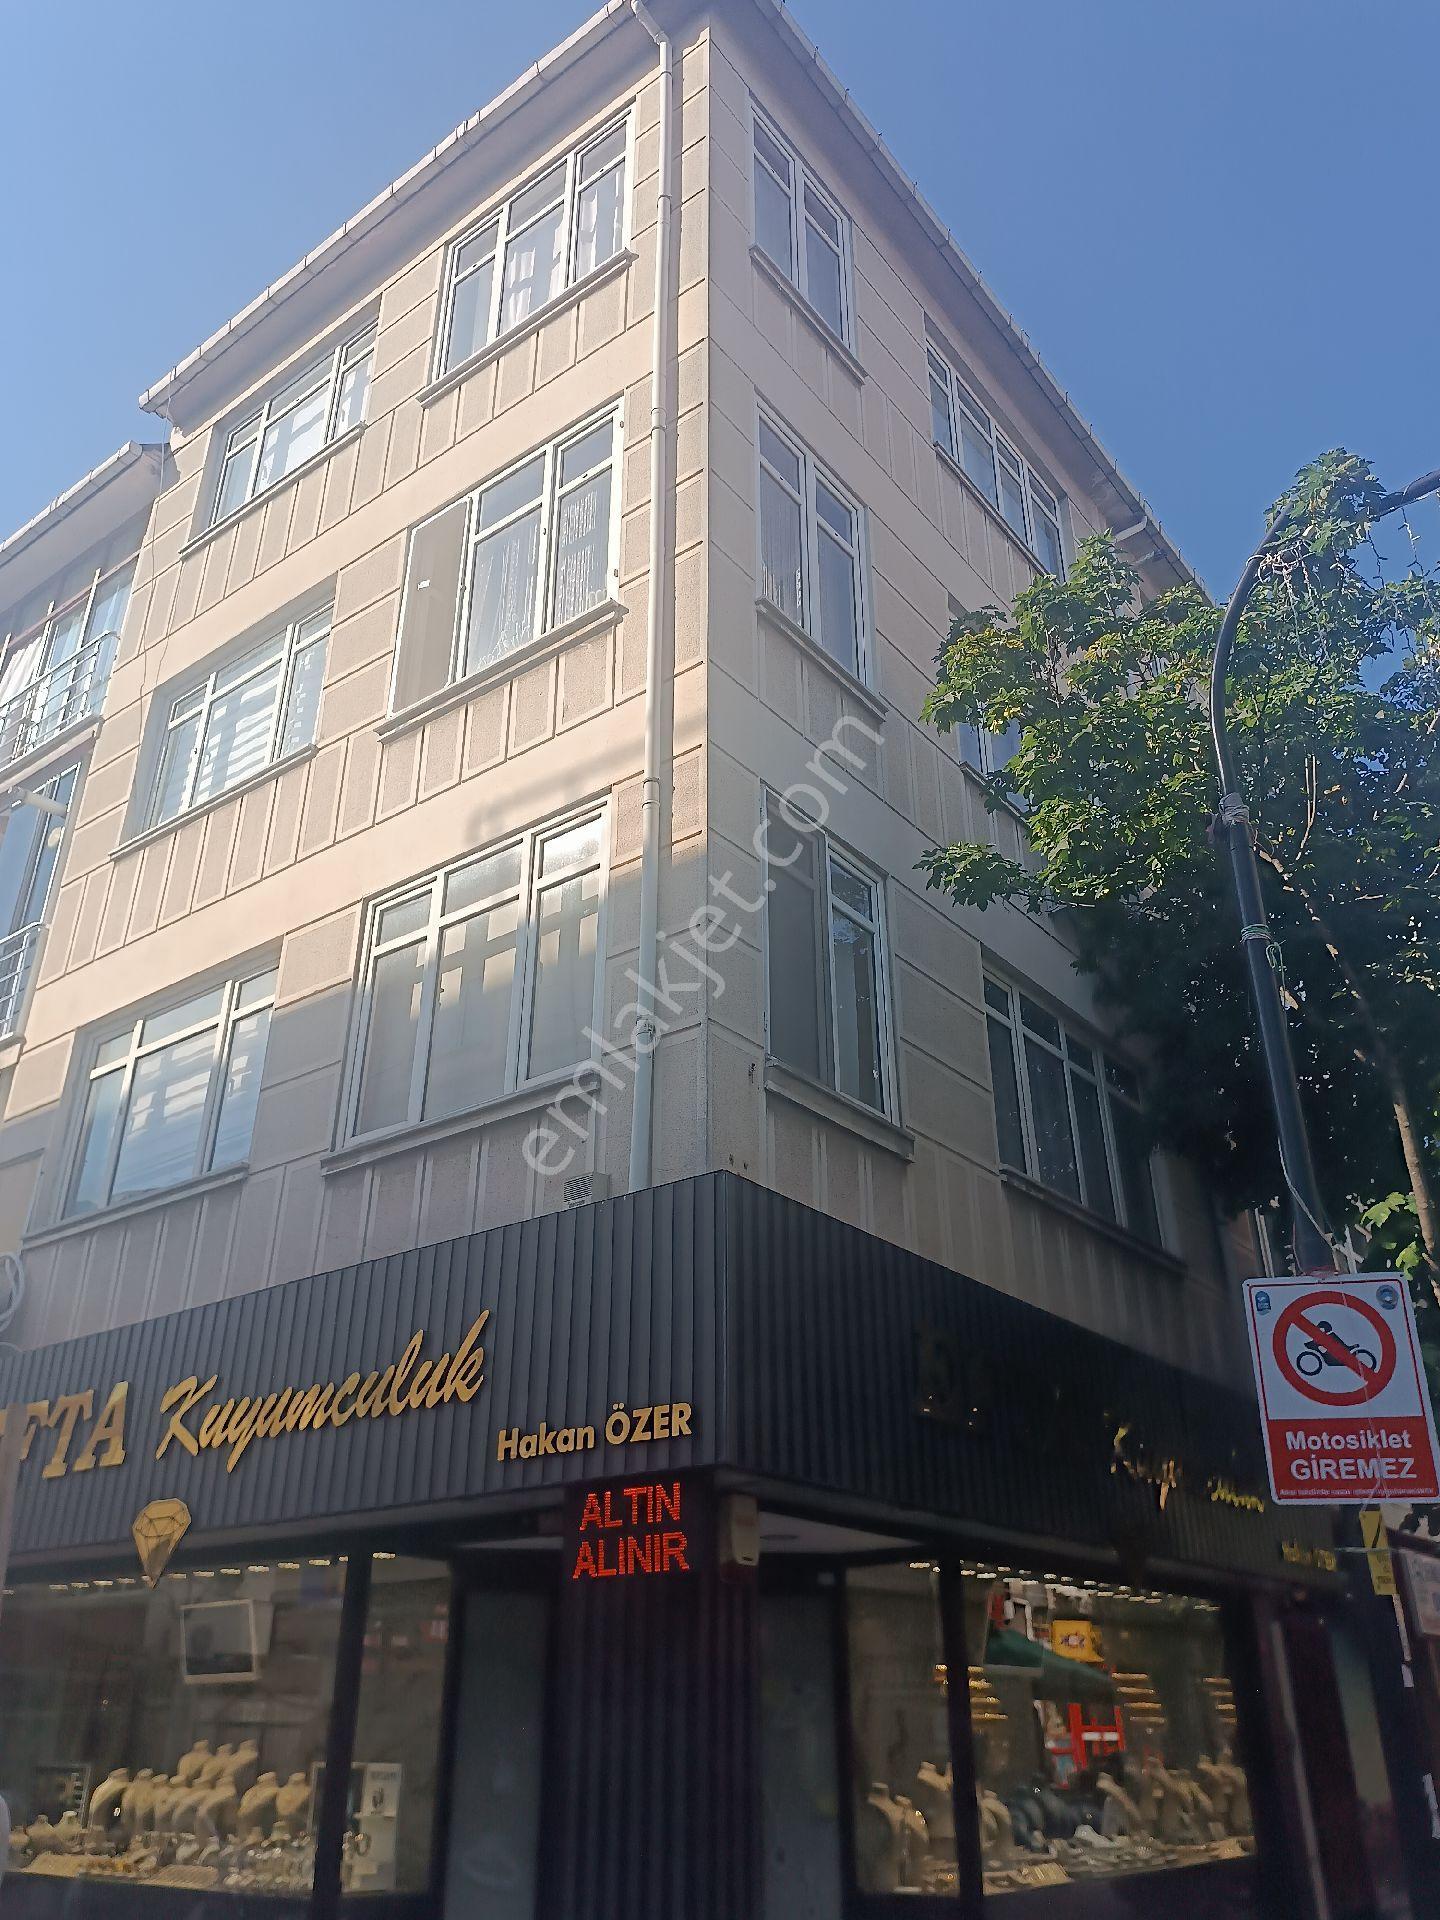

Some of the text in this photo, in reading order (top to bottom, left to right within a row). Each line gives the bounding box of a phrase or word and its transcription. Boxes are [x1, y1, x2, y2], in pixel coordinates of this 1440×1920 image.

[155, 1309, 490, 1473] Kuyumculuk
[497, 1402, 692, 1462] Hakan ÖZER
[1285, 1429, 1413, 1451] Motosiklet
[1290, 1453, 1417, 1480] GİREMEZ
[579, 1482, 681, 1531] ALTIN
[572, 1531, 690, 1579] ALINIR
